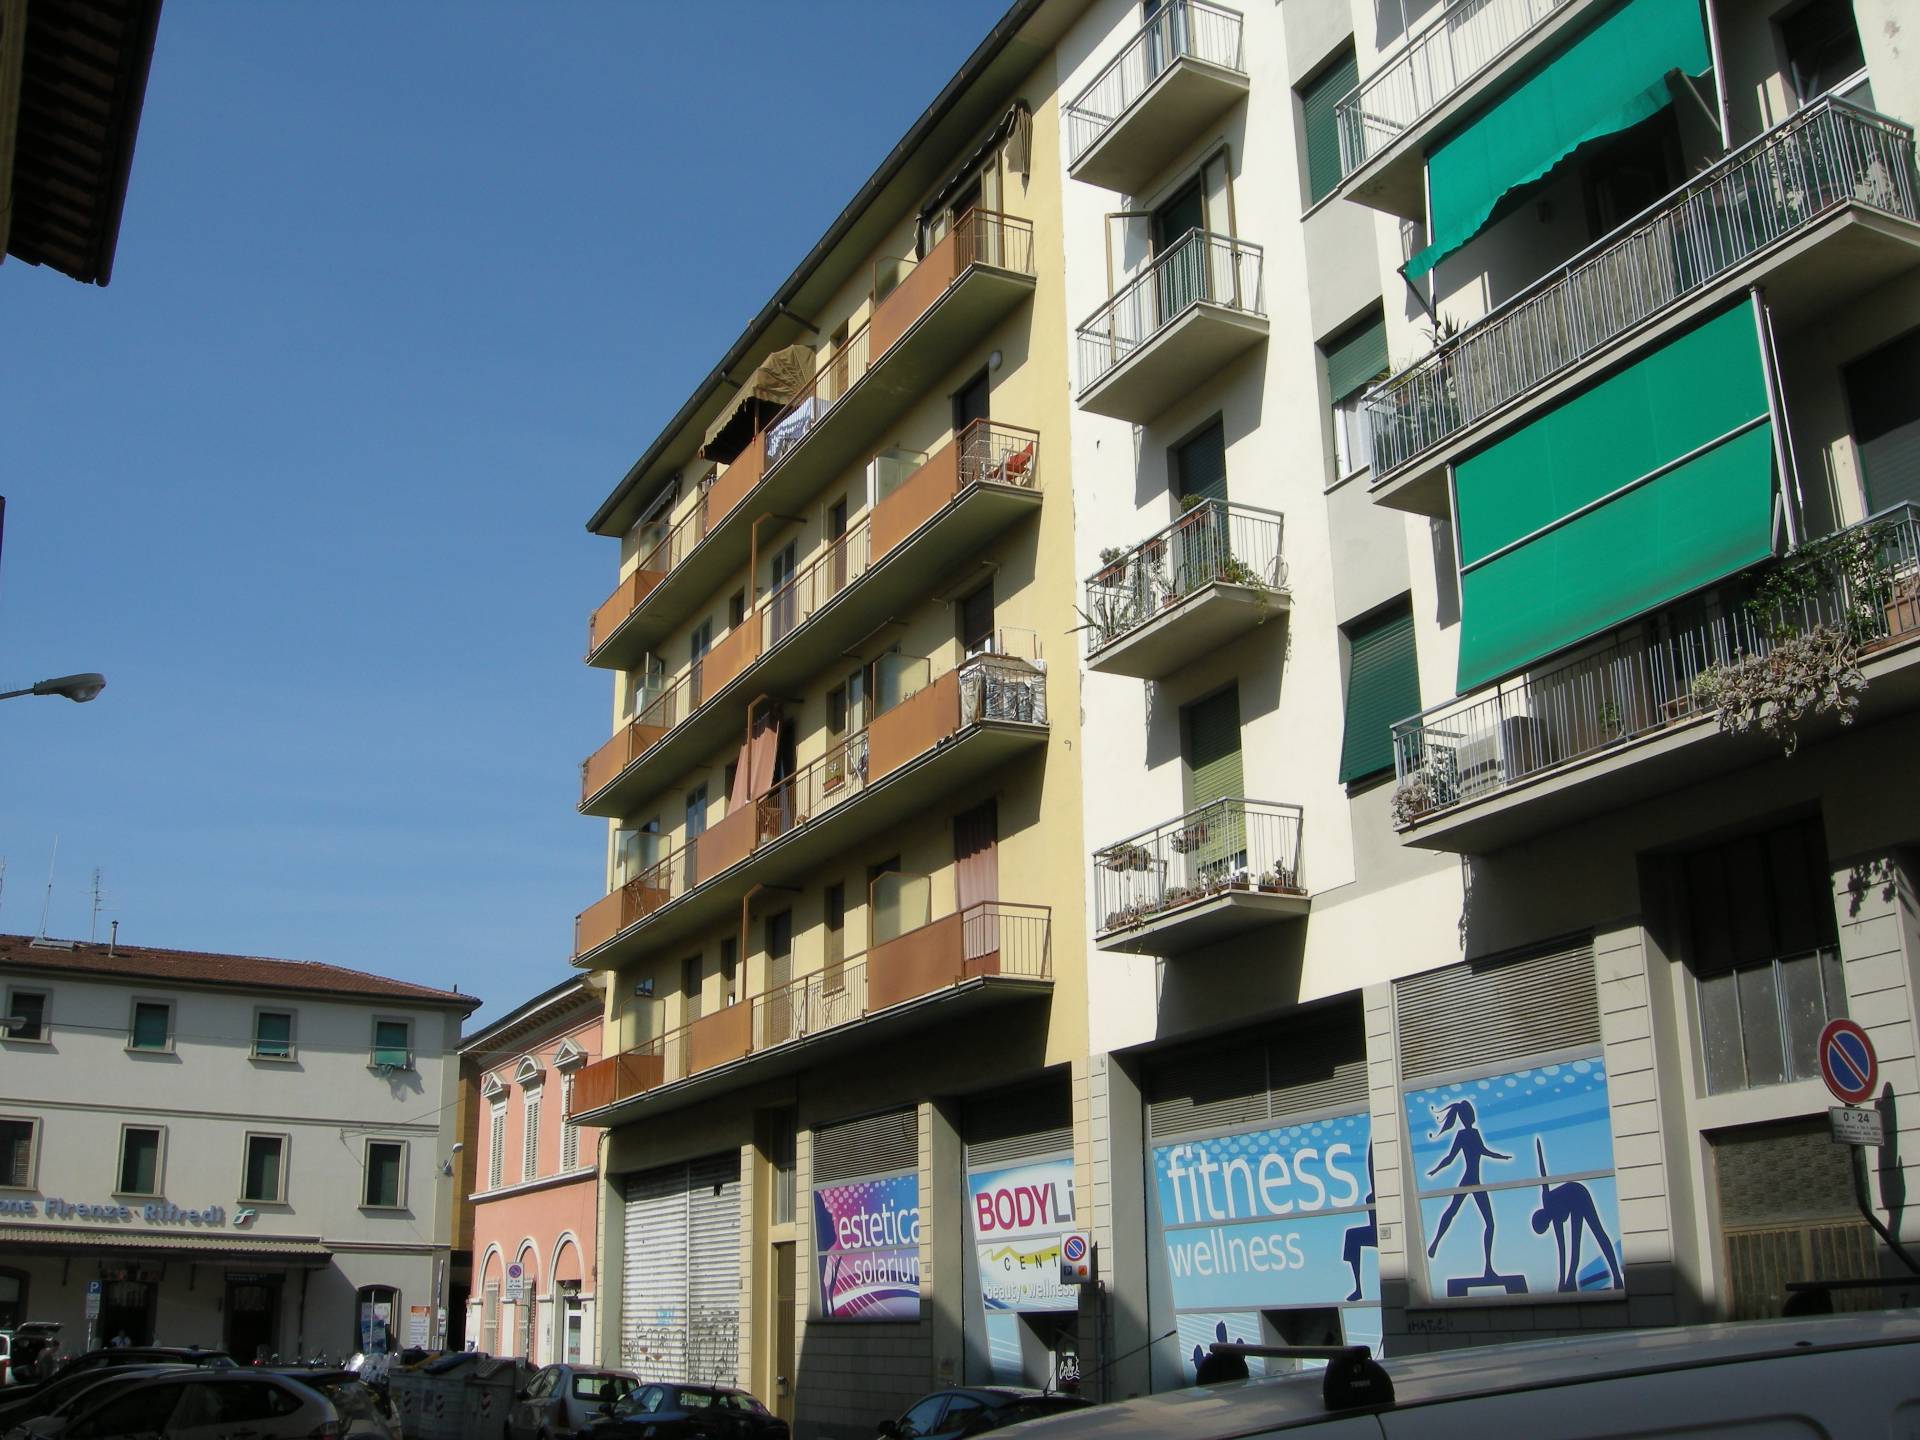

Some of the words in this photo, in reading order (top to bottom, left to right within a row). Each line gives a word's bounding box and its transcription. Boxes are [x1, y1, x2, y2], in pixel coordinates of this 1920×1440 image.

[1857, 1112, 1870, 1123] 24
[1167, 1143, 1359, 1224] fitness
[45, 1198, 129, 1218] Firenze
[143, 1203, 224, 1223] Rifredi
[838, 1198, 920, 1249] estetica
[976, 1179, 1076, 1231] BODYLi
[1168, 1228, 1305, 1278] wellness
[90, 1281, 99, 1293] P
[986, 1282, 1021, 1304] beauty
[1029, 1280, 1076, 1299] wellness
